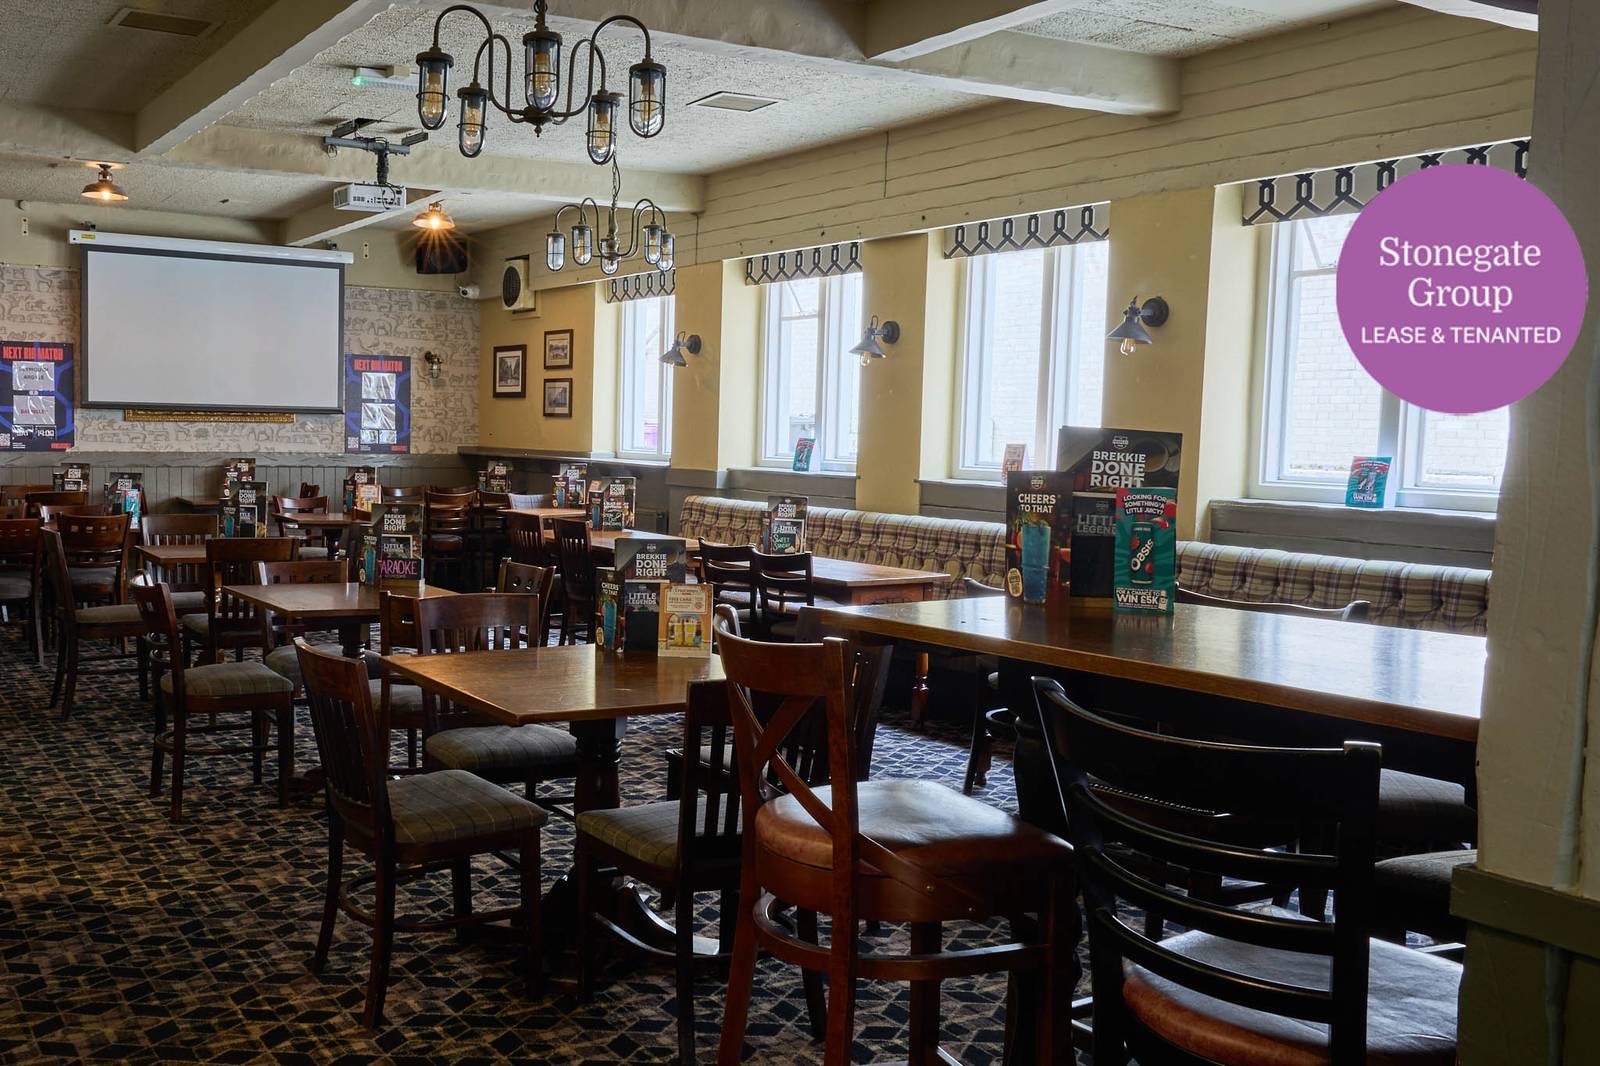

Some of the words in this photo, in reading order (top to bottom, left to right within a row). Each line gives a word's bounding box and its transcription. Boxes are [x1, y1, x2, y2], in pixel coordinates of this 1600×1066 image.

[3, 346, 22, 359] NEXT
[38, 347, 64, 360] MATCH
[1093, 450, 1146, 464] BREKKIE
[1091, 461, 1146, 477] DONE
[1090, 474, 1145, 488] RIGHT
[1018, 493, 1056, 504] CHEERS
[1123, 494, 1152, 502] LOOKING
[1153, 494, 1168, 503] FOR
[1020, 504, 1031, 512] TO
[1032, 504, 1053, 514] THAT
[1124, 501, 1159, 509] SOMETHING
[1077, 513, 1116, 526] LITTL
[1076, 524, 1116, 534] LEGEND
[1131, 538, 1154, 571] Oasis
[381, 560, 418, 575] ARAOKE
[636, 560, 667, 568] DONE
[636, 568, 667, 577] RIGHT
[601, 582, 620, 590] CHEERS
[1117, 593, 1138, 604] WIN
[1140, 595, 1159, 604] £5K
